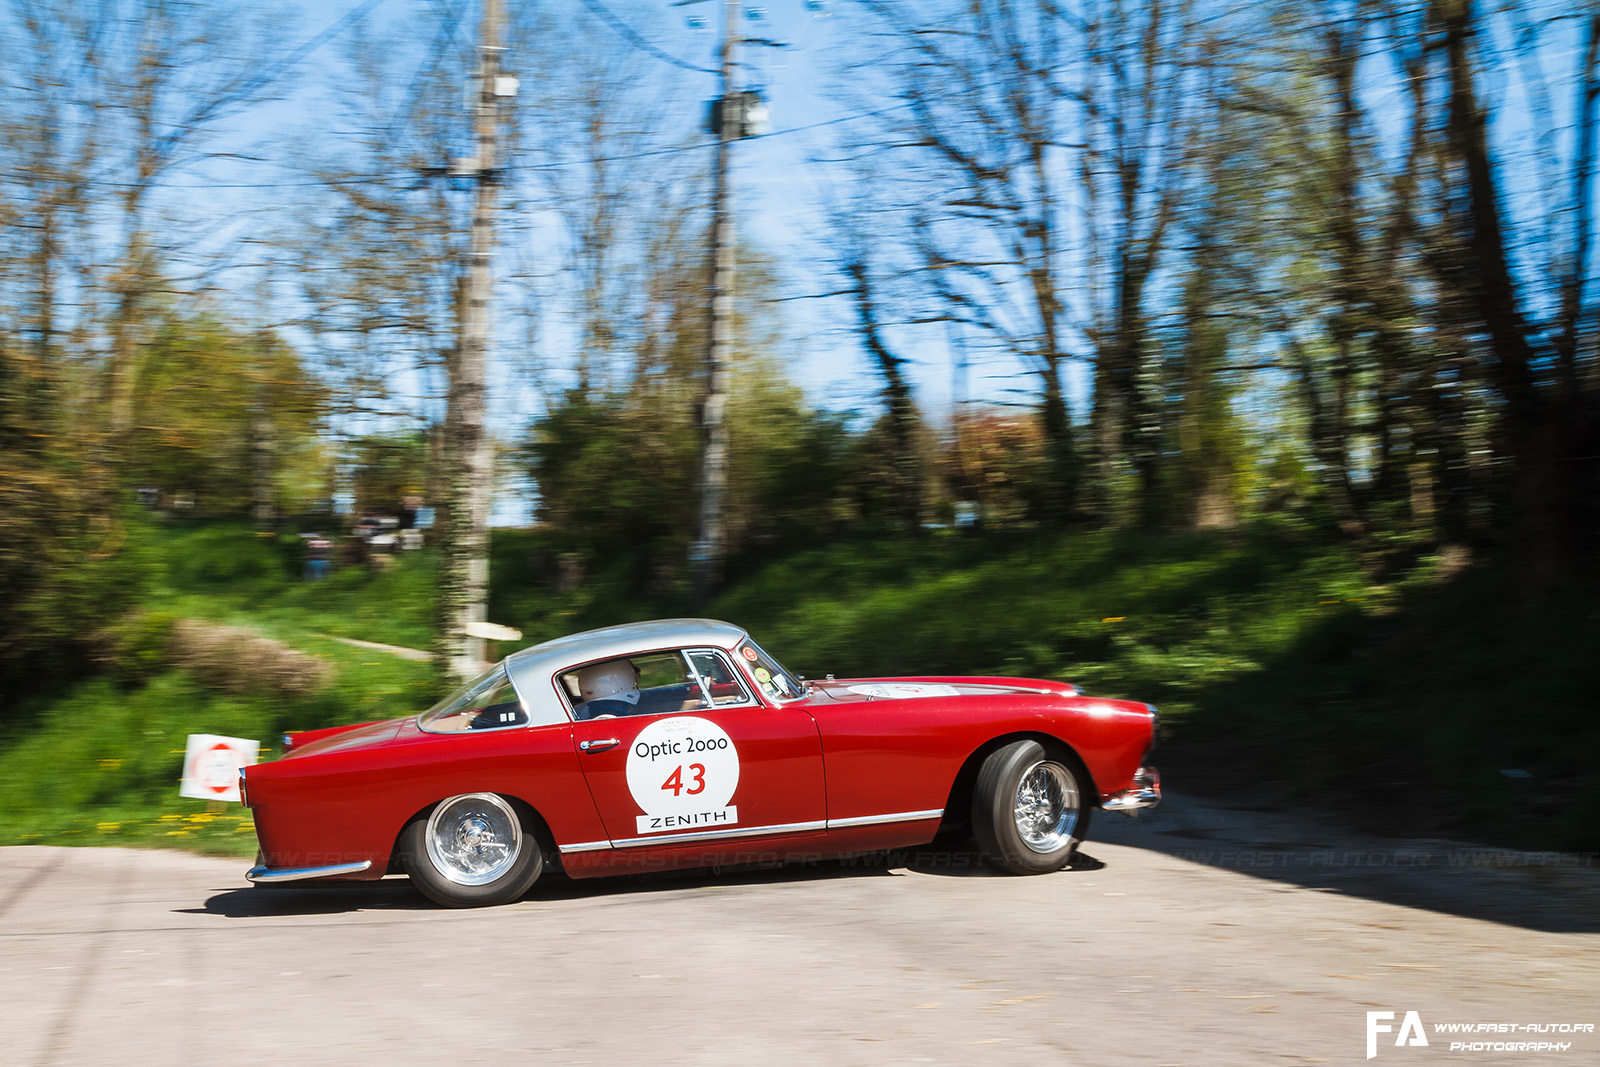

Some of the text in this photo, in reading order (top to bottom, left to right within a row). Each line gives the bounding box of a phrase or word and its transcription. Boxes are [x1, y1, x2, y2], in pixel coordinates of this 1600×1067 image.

[635, 737, 728, 762] Optic 2000
[661, 763, 706, 797] 43
[650, 811, 727, 829] ZENITH
